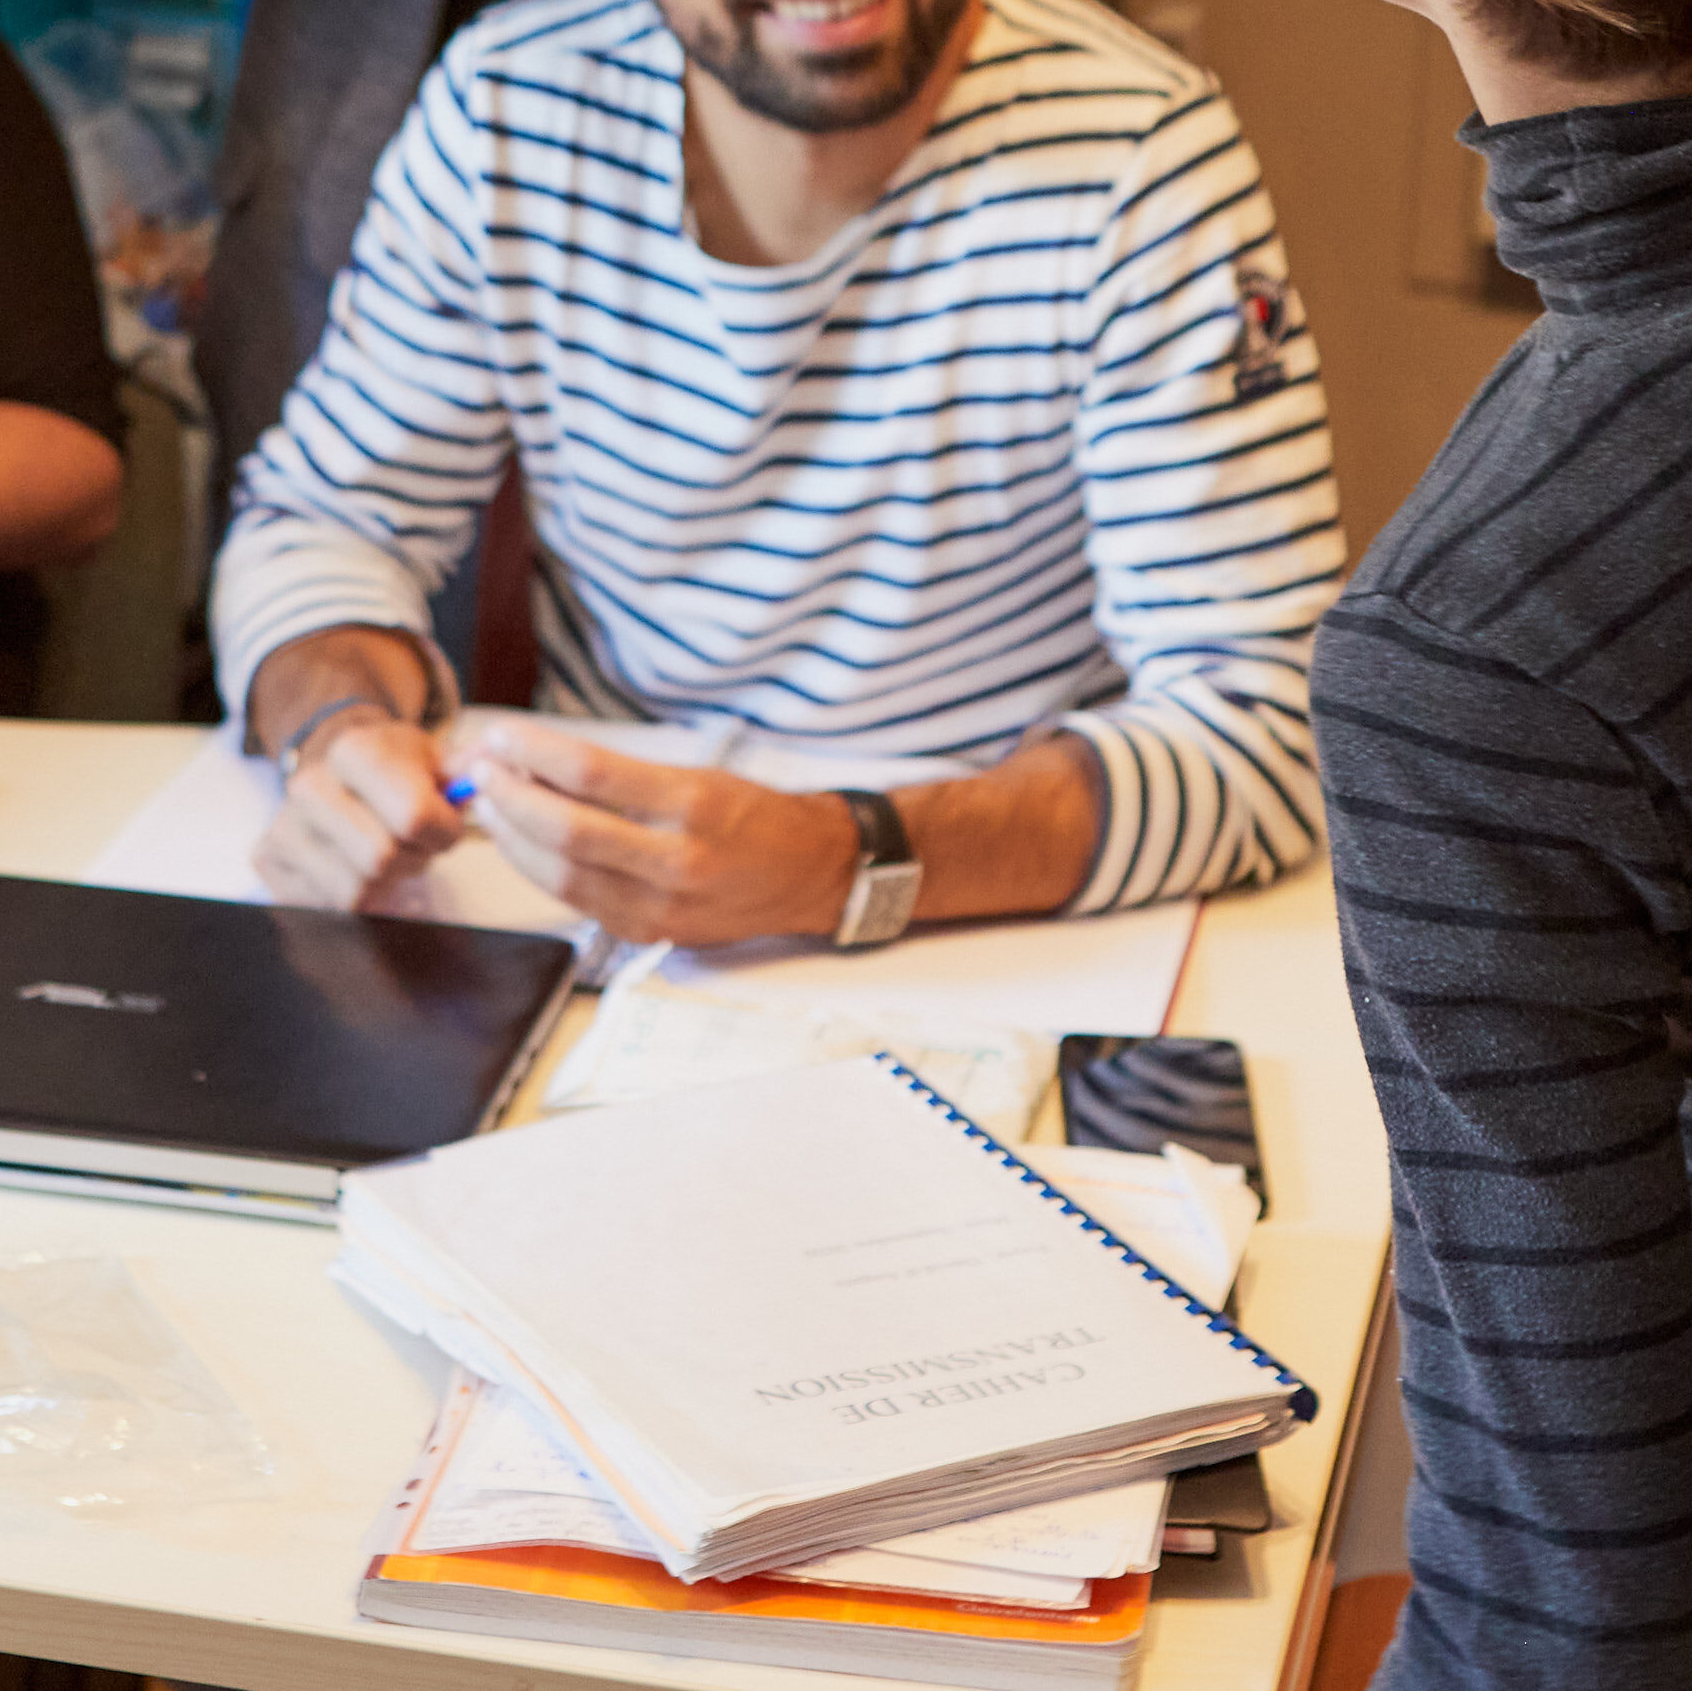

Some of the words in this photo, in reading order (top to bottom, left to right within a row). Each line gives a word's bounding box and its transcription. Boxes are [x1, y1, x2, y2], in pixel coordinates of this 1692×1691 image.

[754, 1326, 1107, 1406] TRANSMISSION
[908, 1361, 1088, 1409] CAHIER
[831, 1396, 905, 1426] DE
